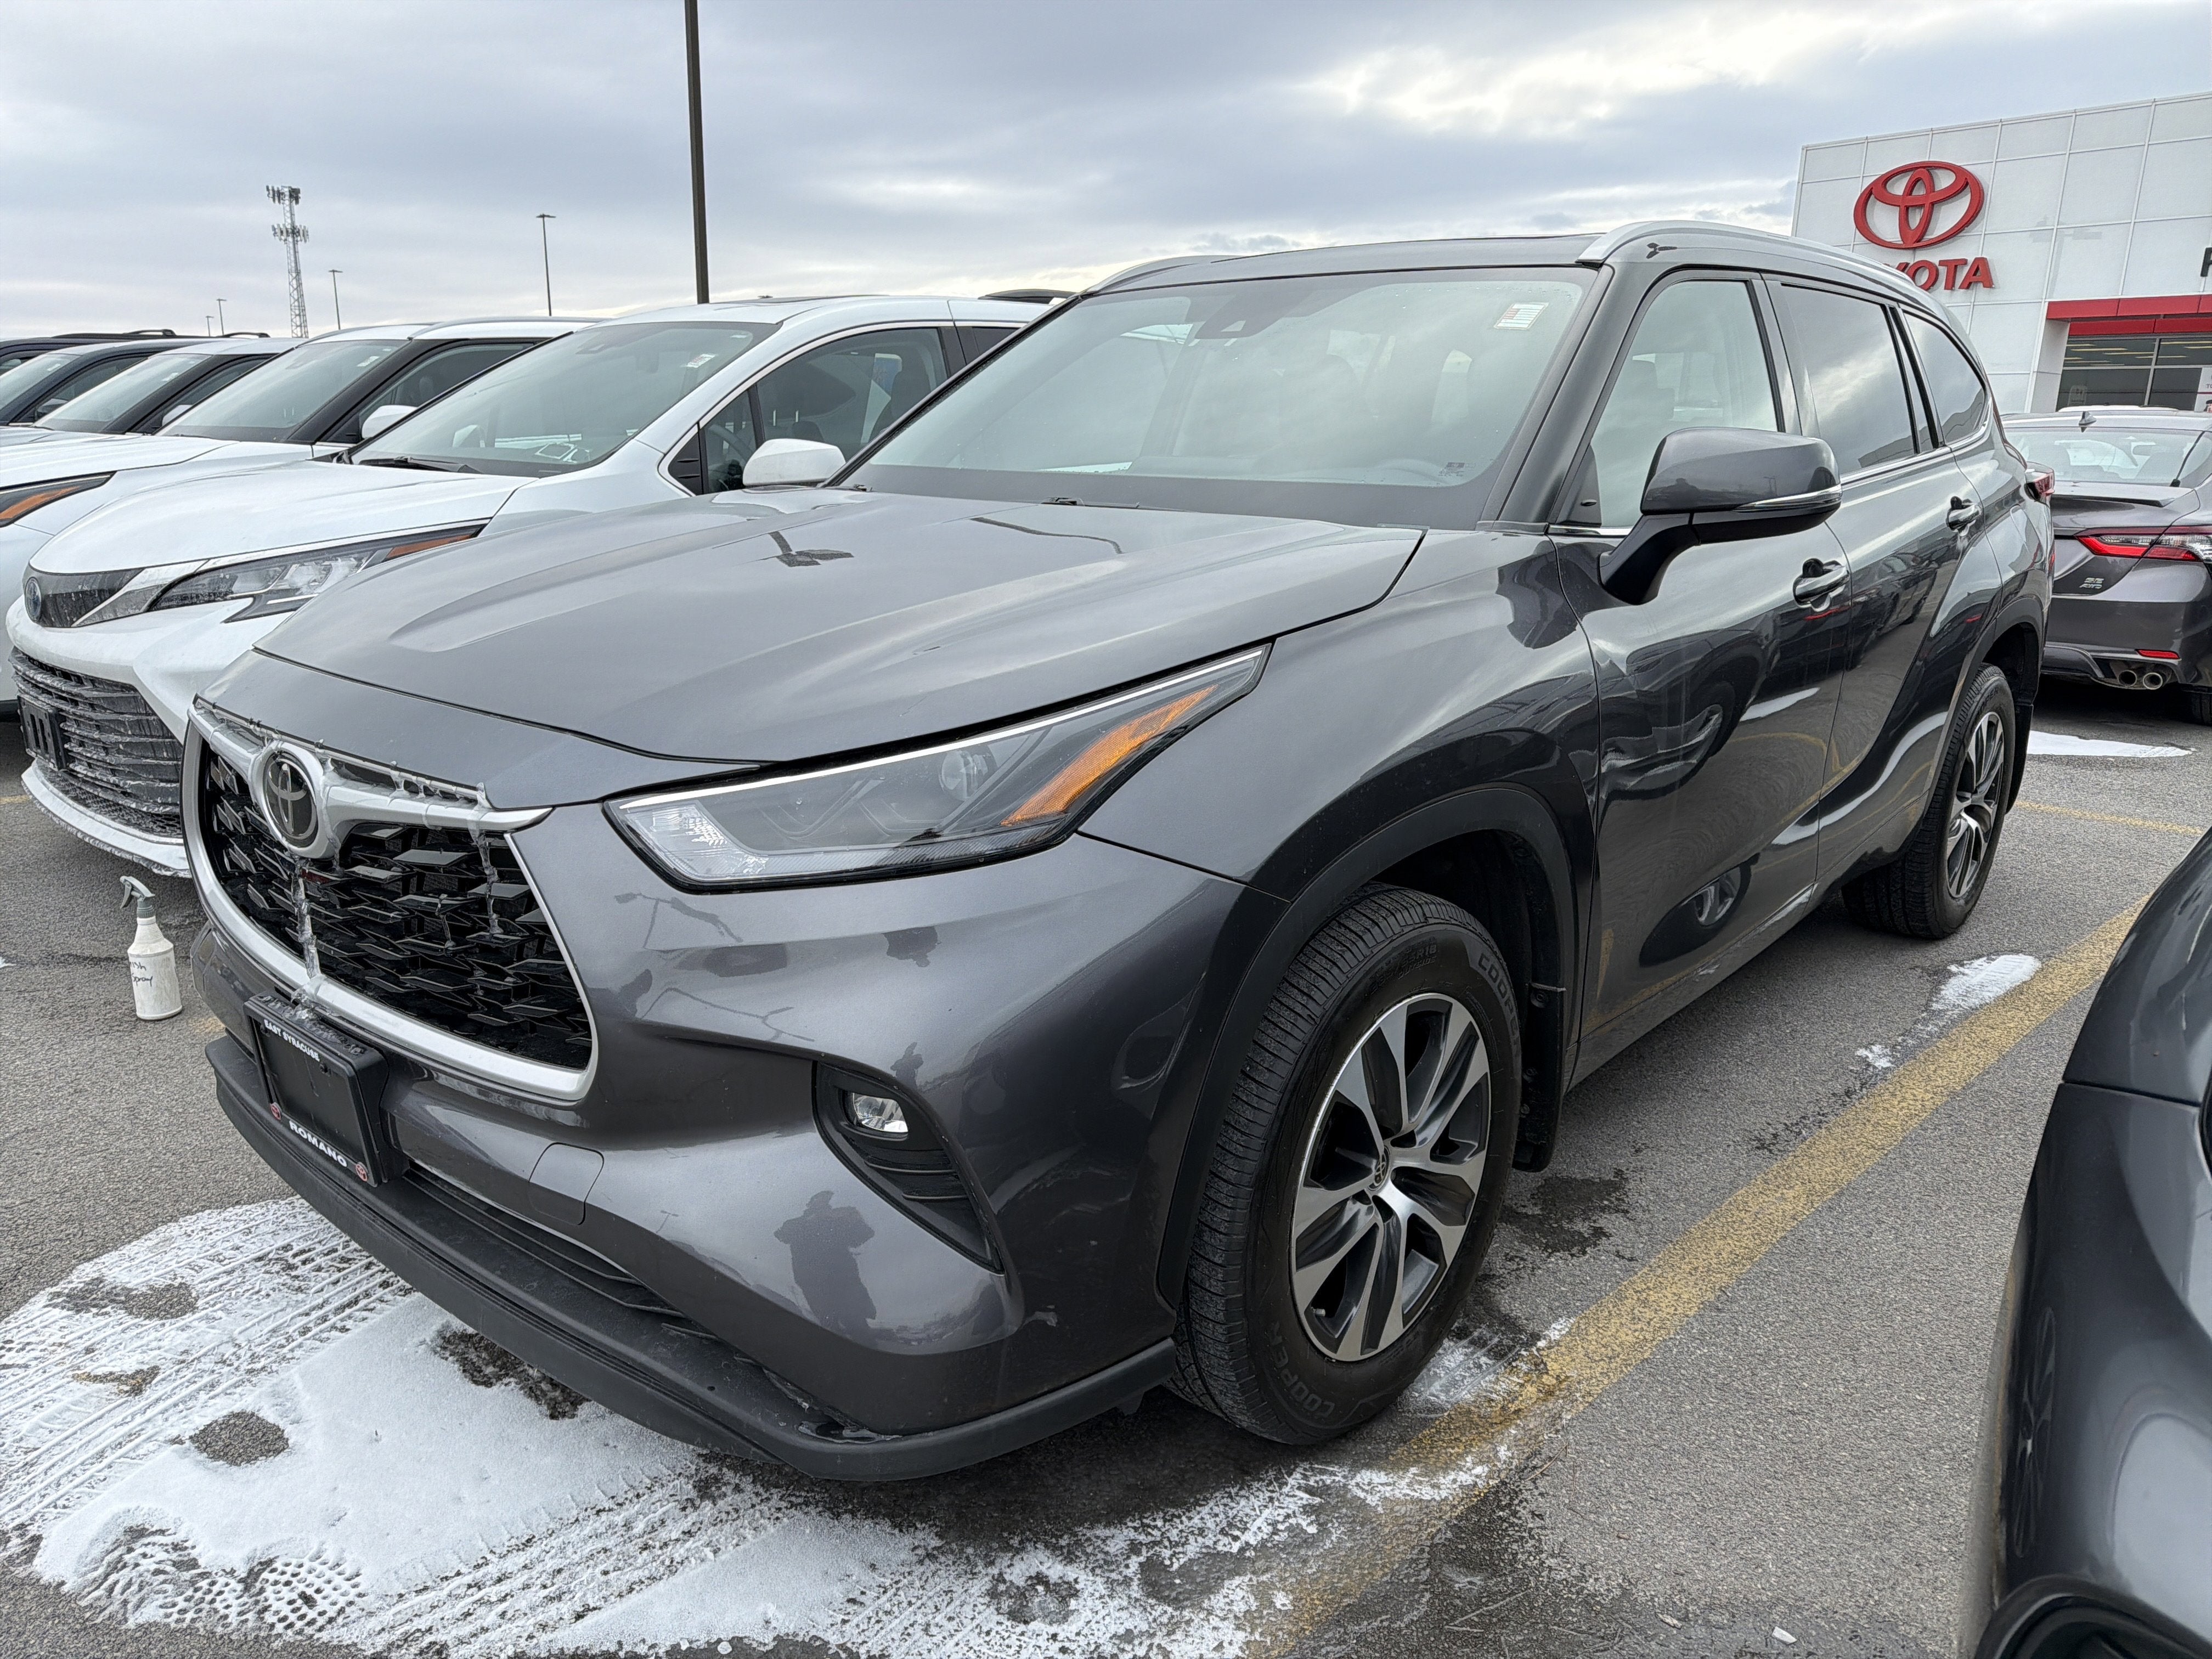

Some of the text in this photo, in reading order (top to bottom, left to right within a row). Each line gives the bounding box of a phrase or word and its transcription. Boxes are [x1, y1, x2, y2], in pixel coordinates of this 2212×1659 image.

[263, 1019, 320, 1062] EAST SYRACUSE
[289, 1120, 347, 1167] ROMANO
